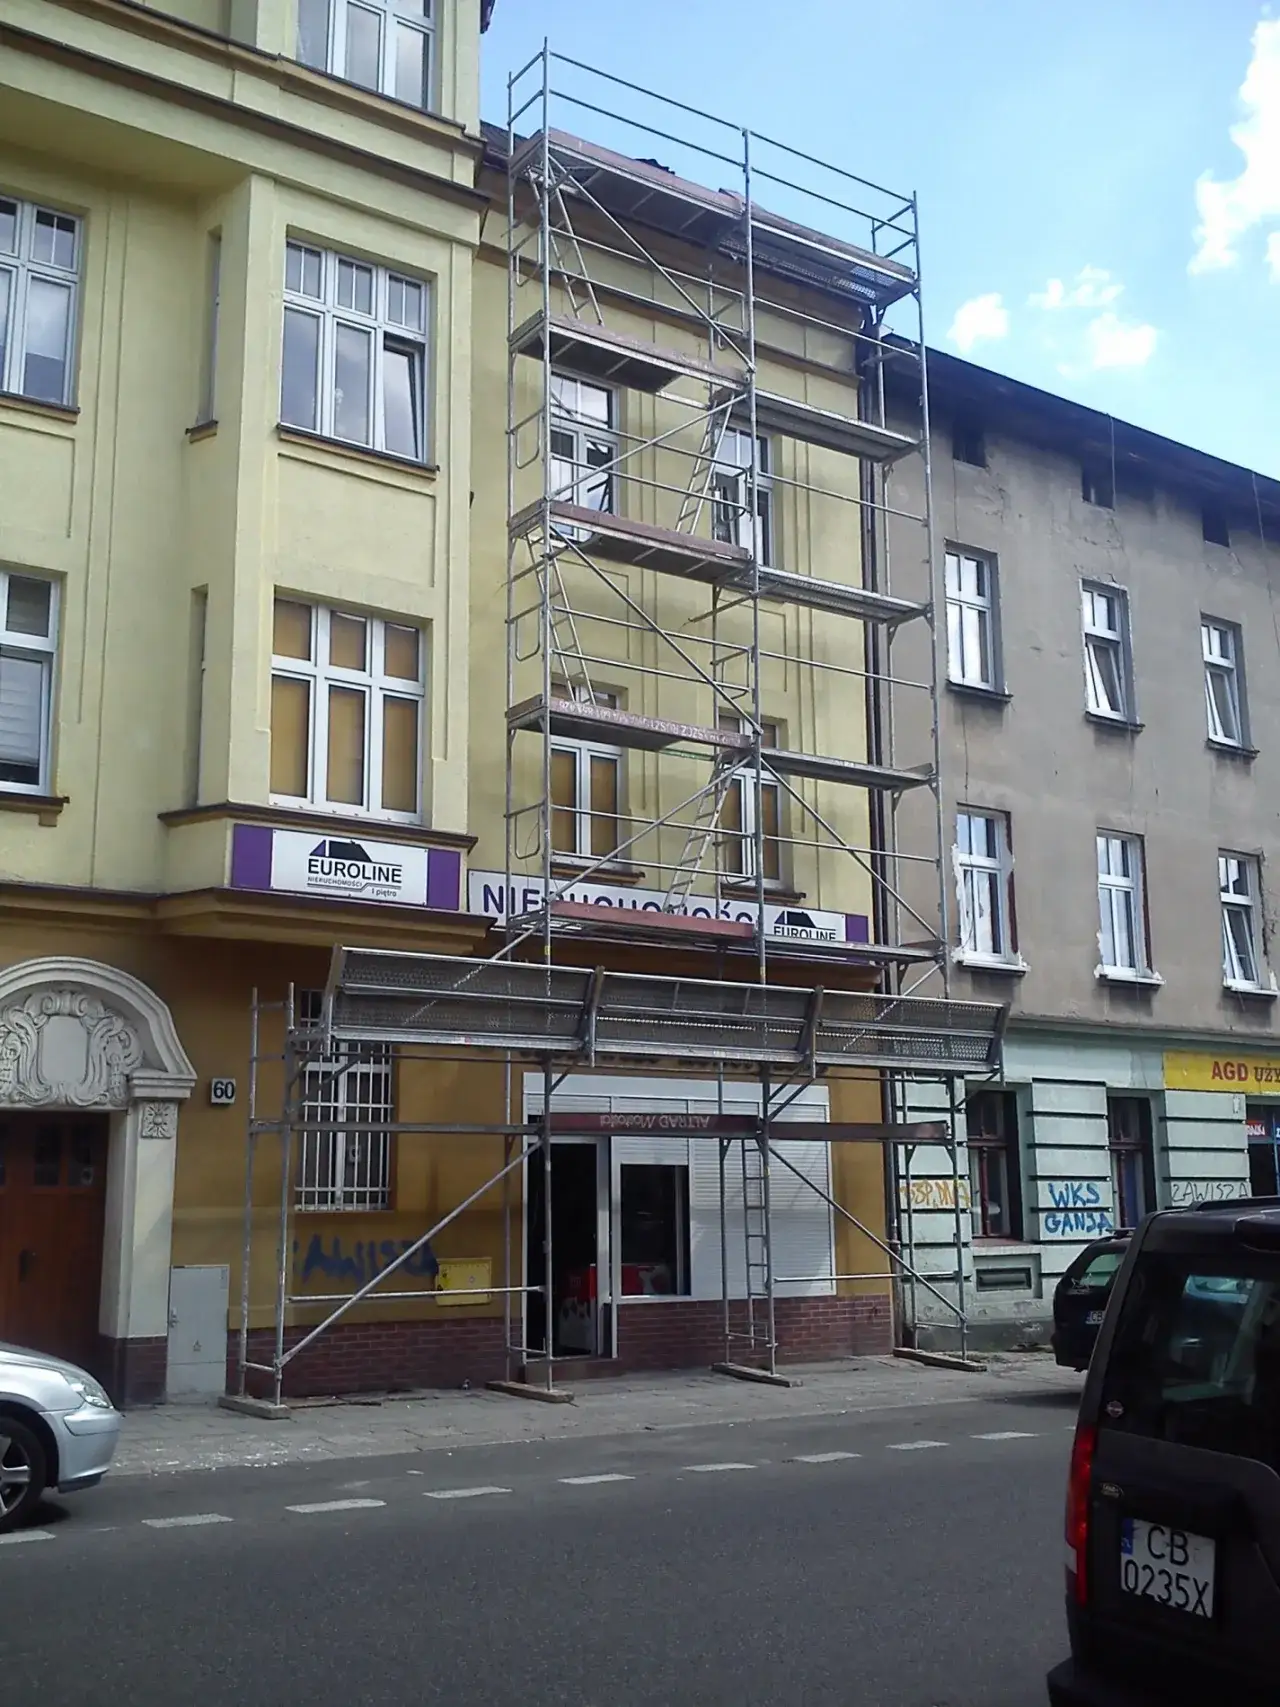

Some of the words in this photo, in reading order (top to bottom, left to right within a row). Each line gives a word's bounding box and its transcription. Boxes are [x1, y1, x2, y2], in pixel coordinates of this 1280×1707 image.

[308, 858, 402, 884] EUROLINE
[1211, 1061, 1249, 1081] AGD
[213, 1081, 235, 1100] 60
[1048, 1182, 1101, 1208] WKS
[1147, 1526, 1190, 1566] CB
[1124, 1559, 1210, 1619] 0235X
